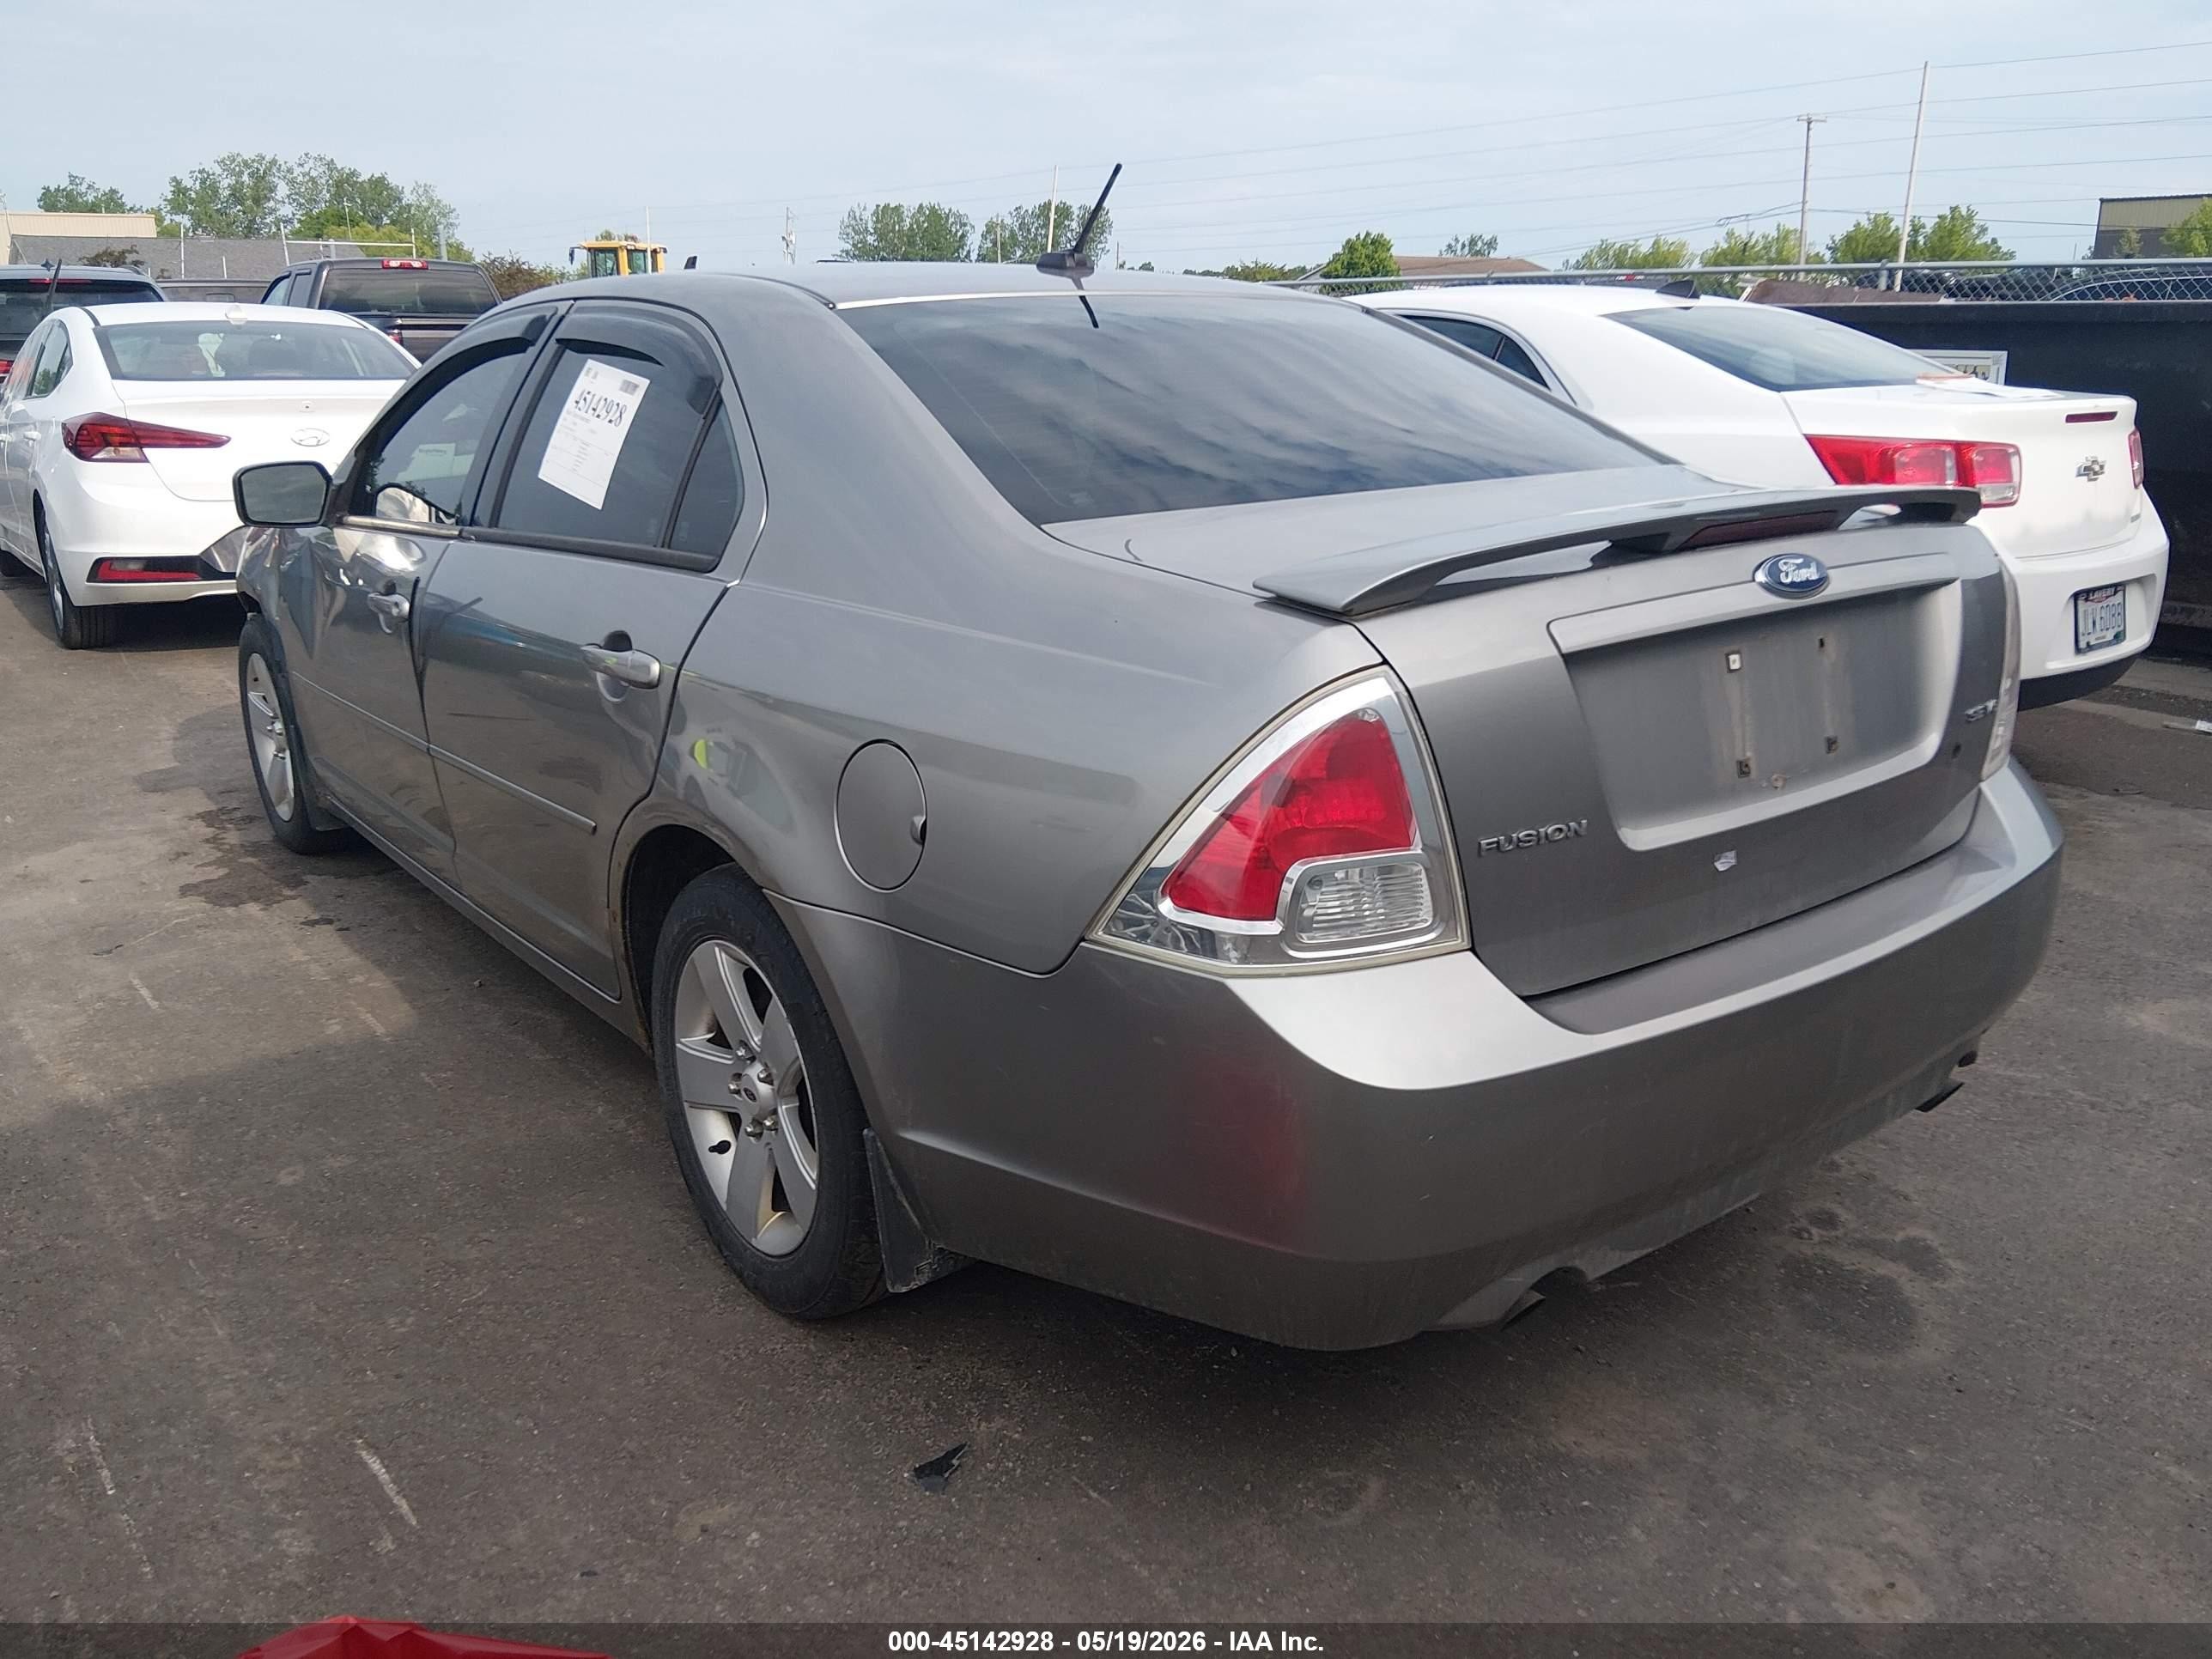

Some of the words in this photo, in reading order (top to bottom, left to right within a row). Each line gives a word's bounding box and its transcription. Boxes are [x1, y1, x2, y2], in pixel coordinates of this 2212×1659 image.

[574, 388, 628, 428] 45142928
[1778, 557, 1820, 584] Ford
[1478, 819, 1588, 857] FUSION
